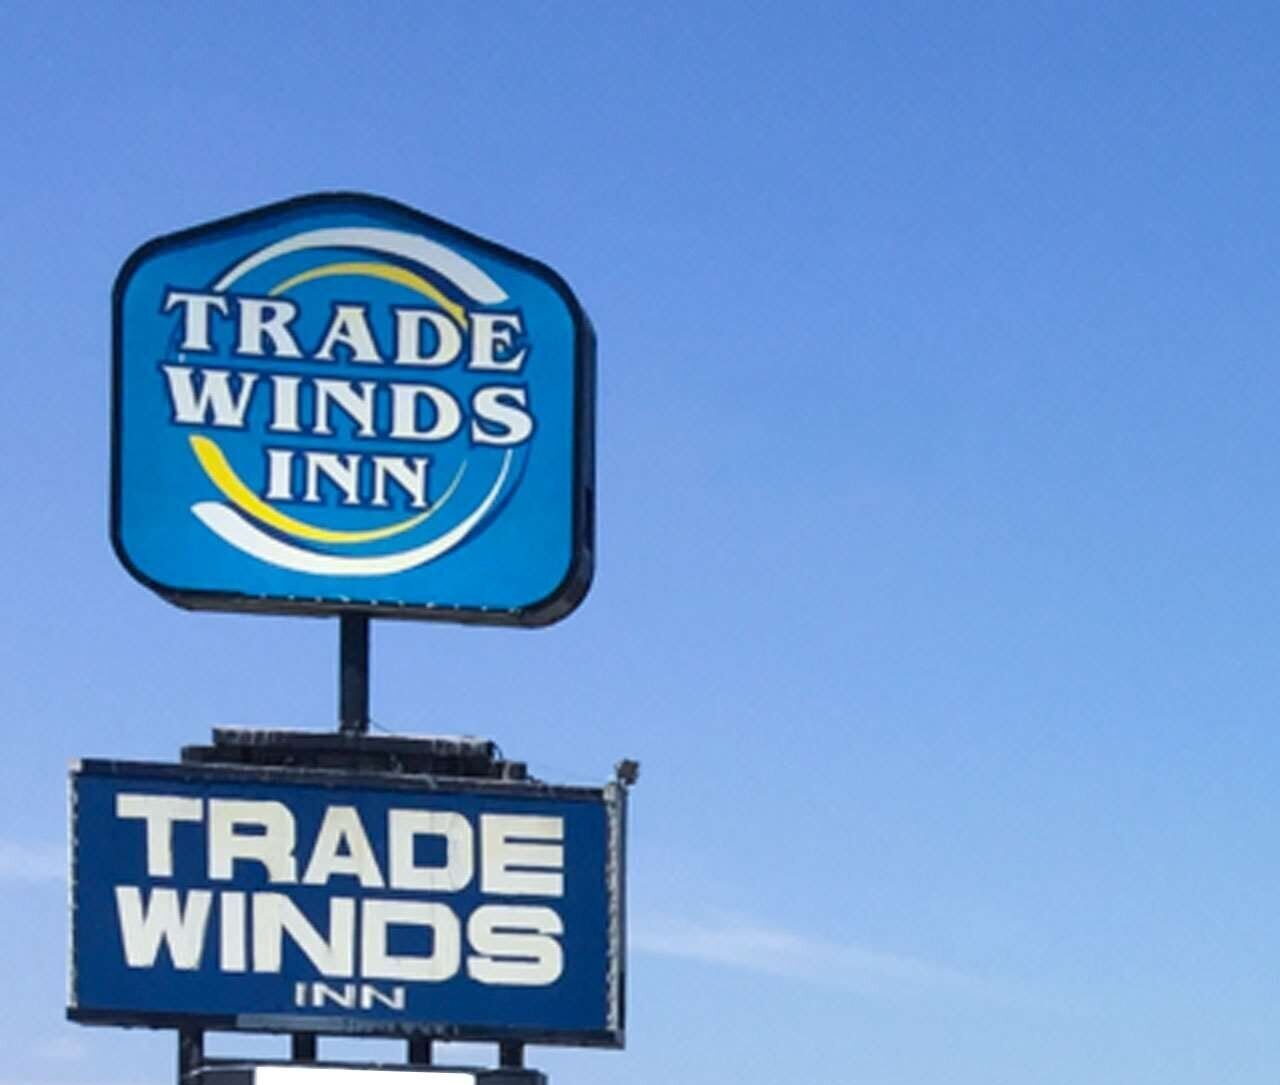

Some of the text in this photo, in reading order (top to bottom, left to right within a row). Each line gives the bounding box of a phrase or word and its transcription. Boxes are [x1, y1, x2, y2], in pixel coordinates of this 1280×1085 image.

[166, 292, 530, 370] TRADE
[163, 366, 533, 446] WINDS
[265, 449, 430, 508] INN
[116, 792, 565, 897] TRADE
[114, 885, 565, 987] WINDS
[295, 983, 406, 1011] INN
